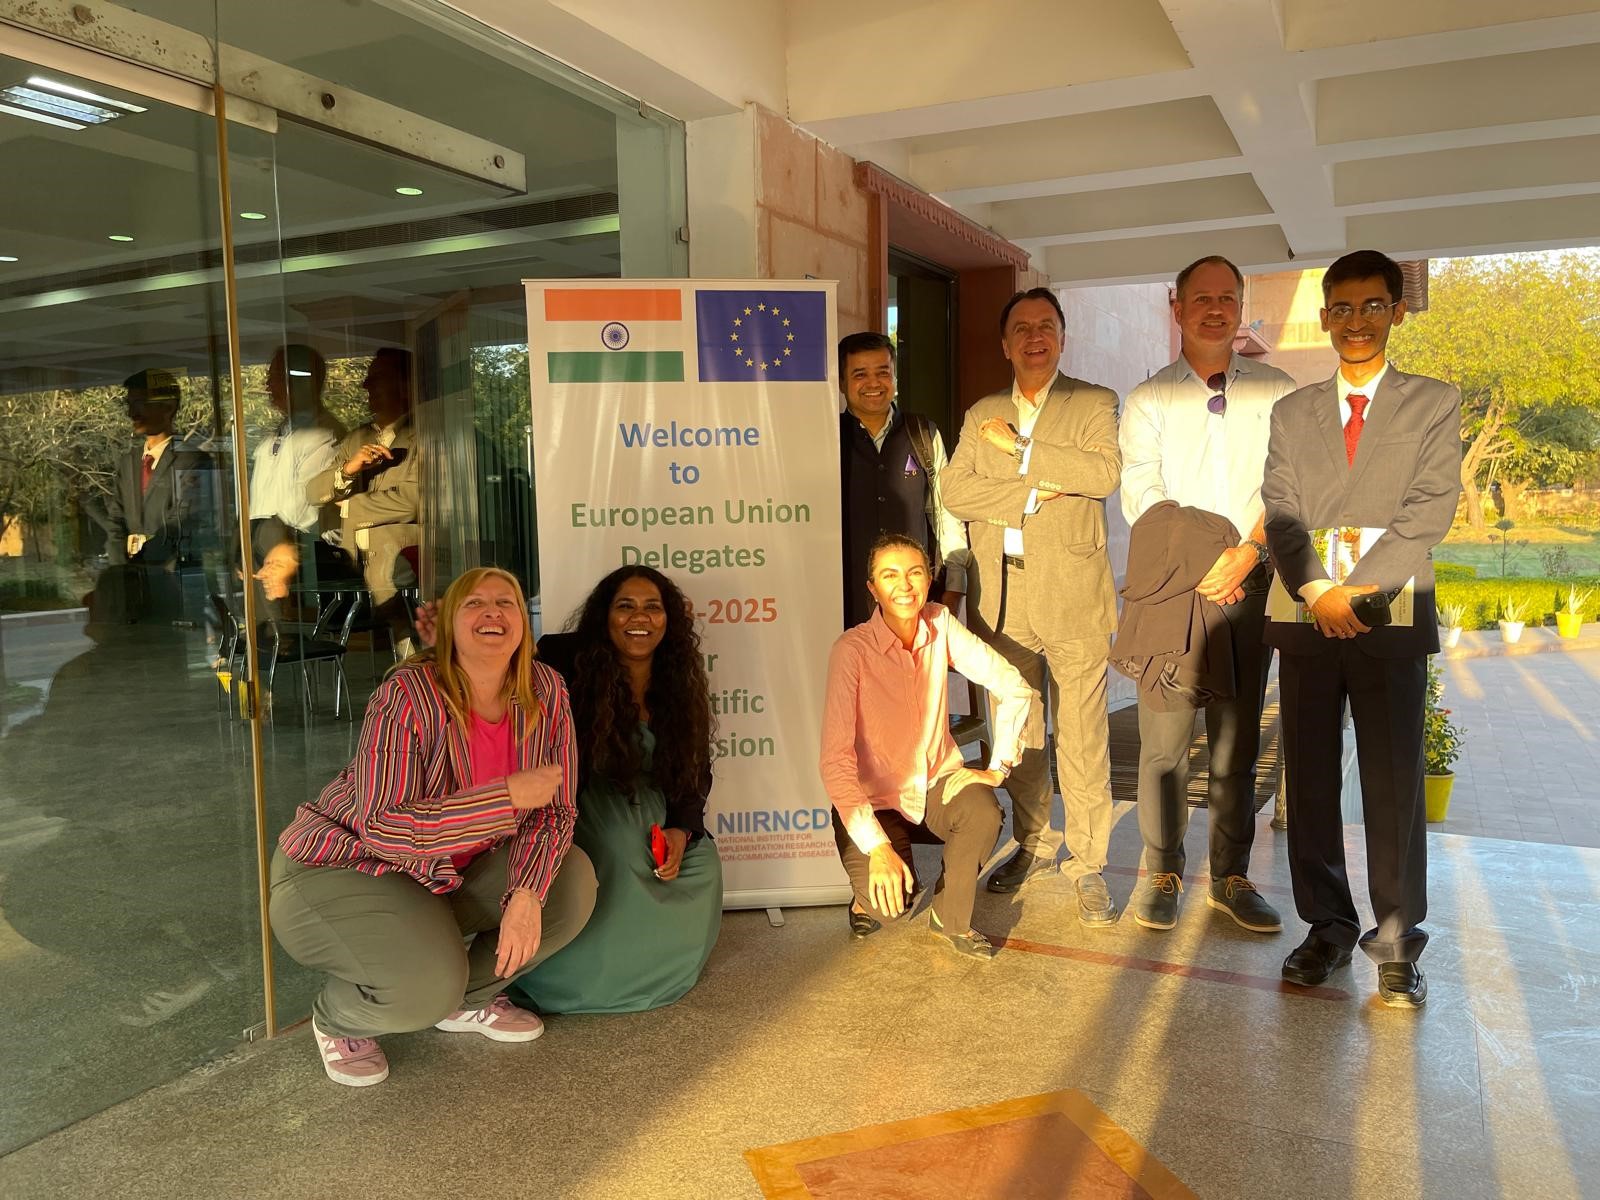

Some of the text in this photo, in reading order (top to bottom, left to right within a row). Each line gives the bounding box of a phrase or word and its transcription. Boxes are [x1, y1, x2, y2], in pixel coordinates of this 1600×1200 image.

[619, 421, 760, 448] Welcome
[669, 462, 700, 485] to
[571, 498, 811, 532] European Union
[621, 544, 766, 574] Delegates
[709, 689, 765, 715] tific
[717, 808, 830, 834] NIIRNCD
[717, 832, 812, 844] NATIONAL INSTITUTE FOR
[719, 843, 784, 853] IMPLEMENTATION
[786, 841, 826, 850] RESEARCH
[799, 848, 836, 858] DISEASES
